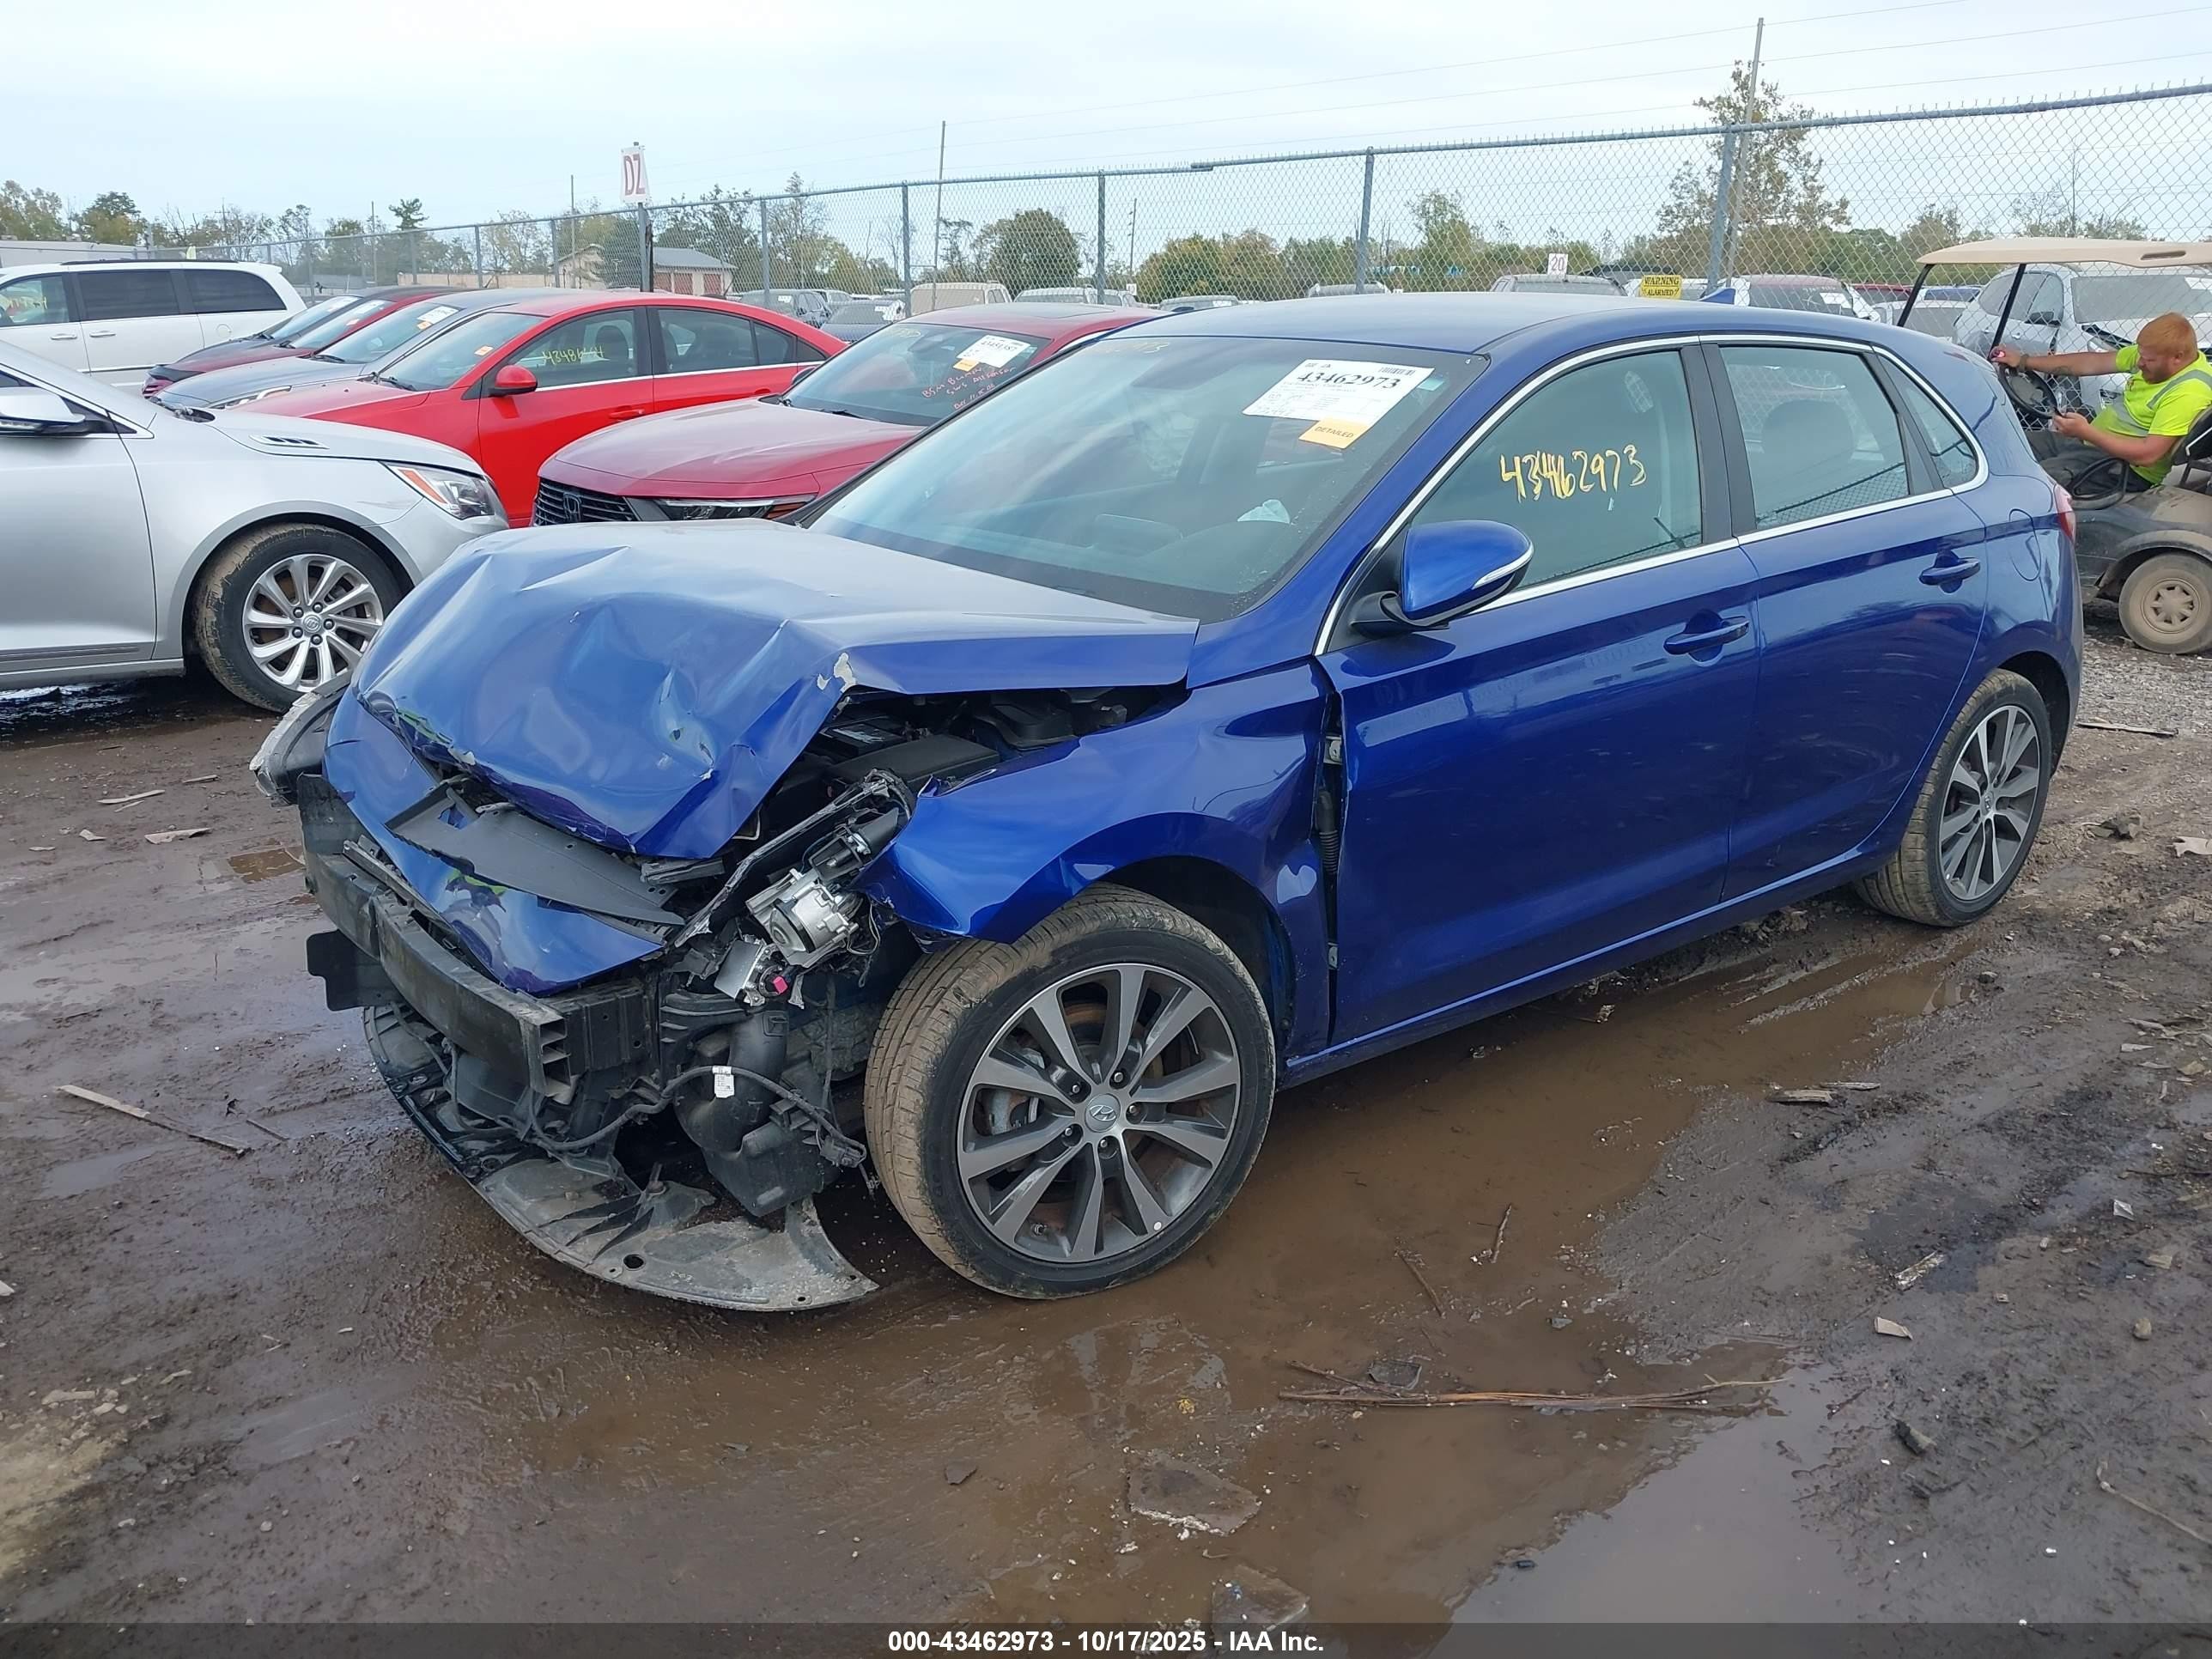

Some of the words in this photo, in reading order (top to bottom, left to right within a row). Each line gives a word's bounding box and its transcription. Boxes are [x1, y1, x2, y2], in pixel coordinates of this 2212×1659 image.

[1551, 256, 1565, 271] 20
[1644, 276, 1680, 285] WARNING
[1297, 371, 1401, 389] 43462973
[1315, 424, 1354, 439] DETAILED
[1499, 444, 1647, 503] 43462973
